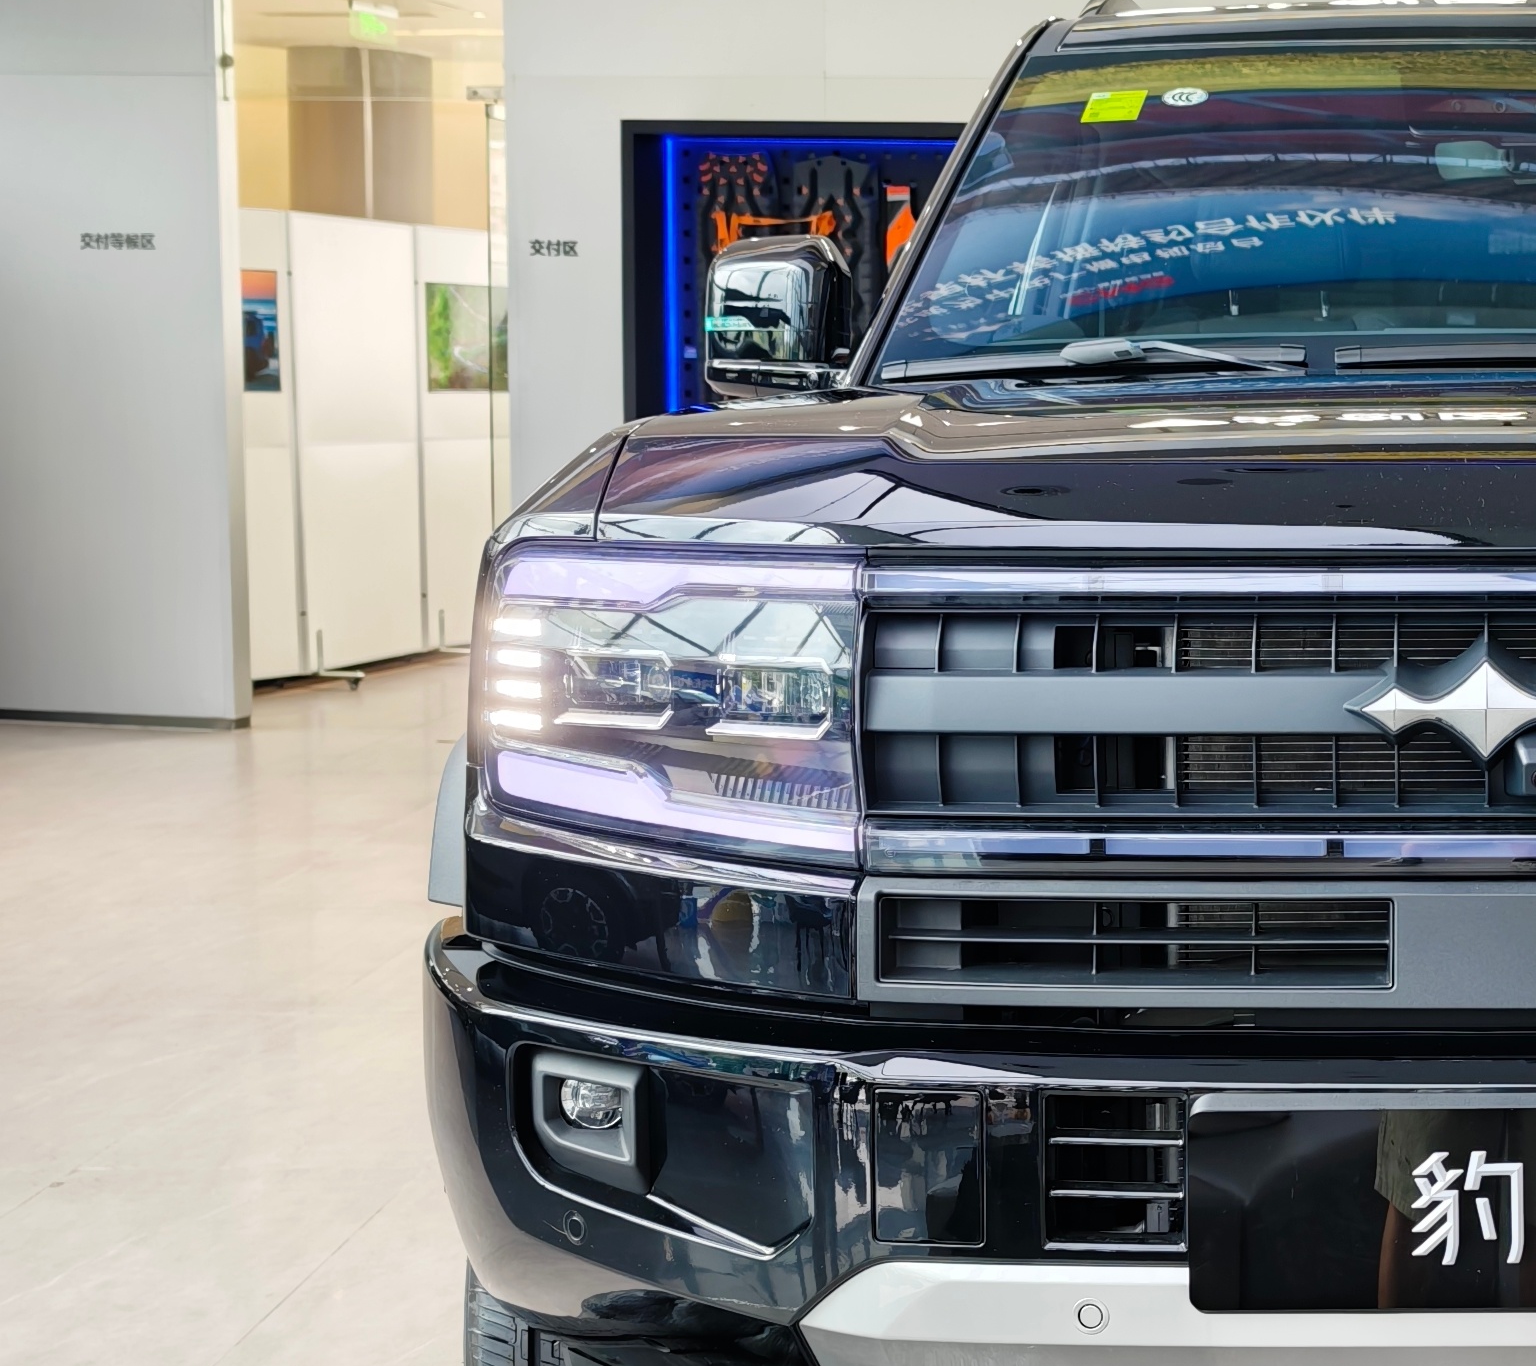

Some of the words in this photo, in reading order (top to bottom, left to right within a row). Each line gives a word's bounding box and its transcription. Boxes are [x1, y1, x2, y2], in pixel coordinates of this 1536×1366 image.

[80, 232, 156, 251] 交付等候区
[529, 239, 579, 257] 交付区
[1410, 1150, 1525, 1266] 豹
